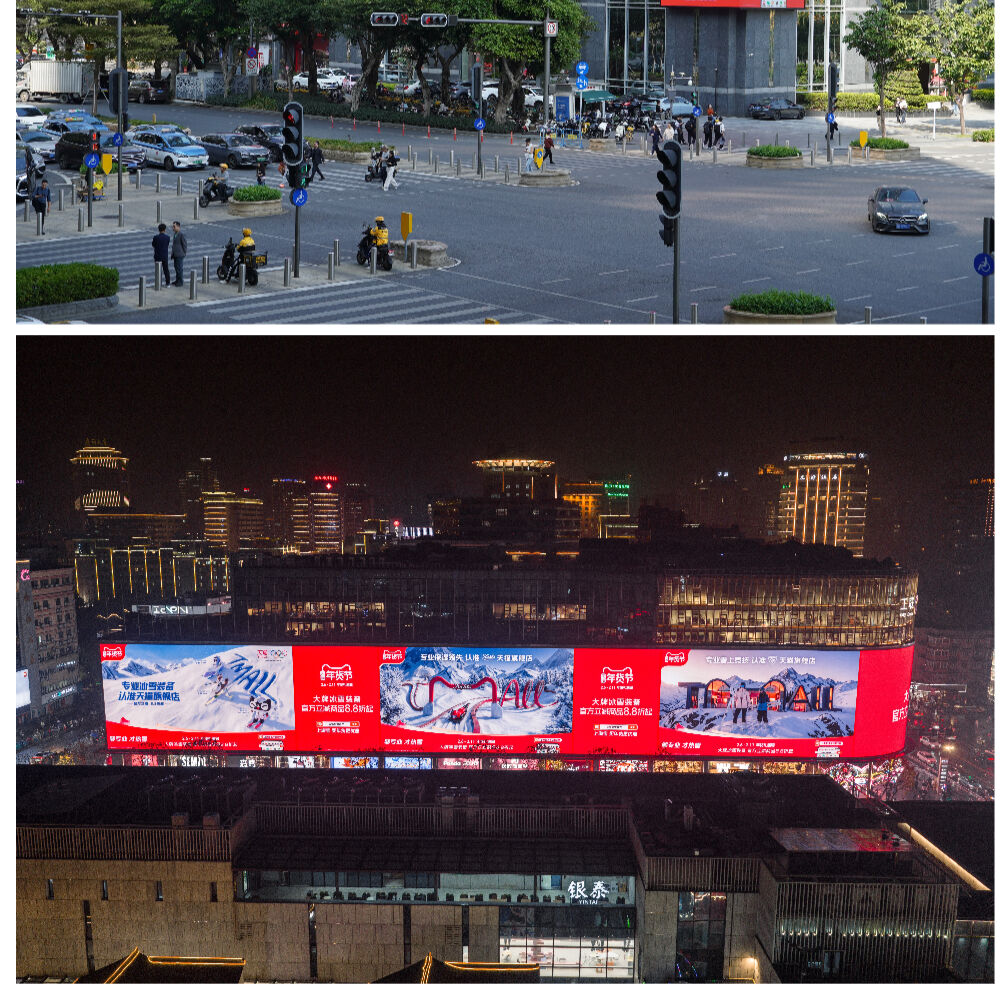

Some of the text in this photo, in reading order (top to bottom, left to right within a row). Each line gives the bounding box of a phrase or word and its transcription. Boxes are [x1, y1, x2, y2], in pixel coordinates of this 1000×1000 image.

[496, 654, 533, 663] 天猫旗舰店
[779, 656, 816, 665] 天猫旗舰店
[320, 670, 353, 682] 年货节
[601, 673, 634, 684] 年货节
[121, 681, 176, 692] 专业冰雪装备
[118, 691, 181, 703] 认准天猫旗舰店
[312, 694, 362, 704] 大牌冰雪装备
[591, 697, 641, 707] 大牌冰雪装备
[301, 703, 374, 714] 官方立减商品8.8折起
[579, 706, 653, 717] 官方立减商品8.8折起
[567, 881, 609, 899] 银泰
